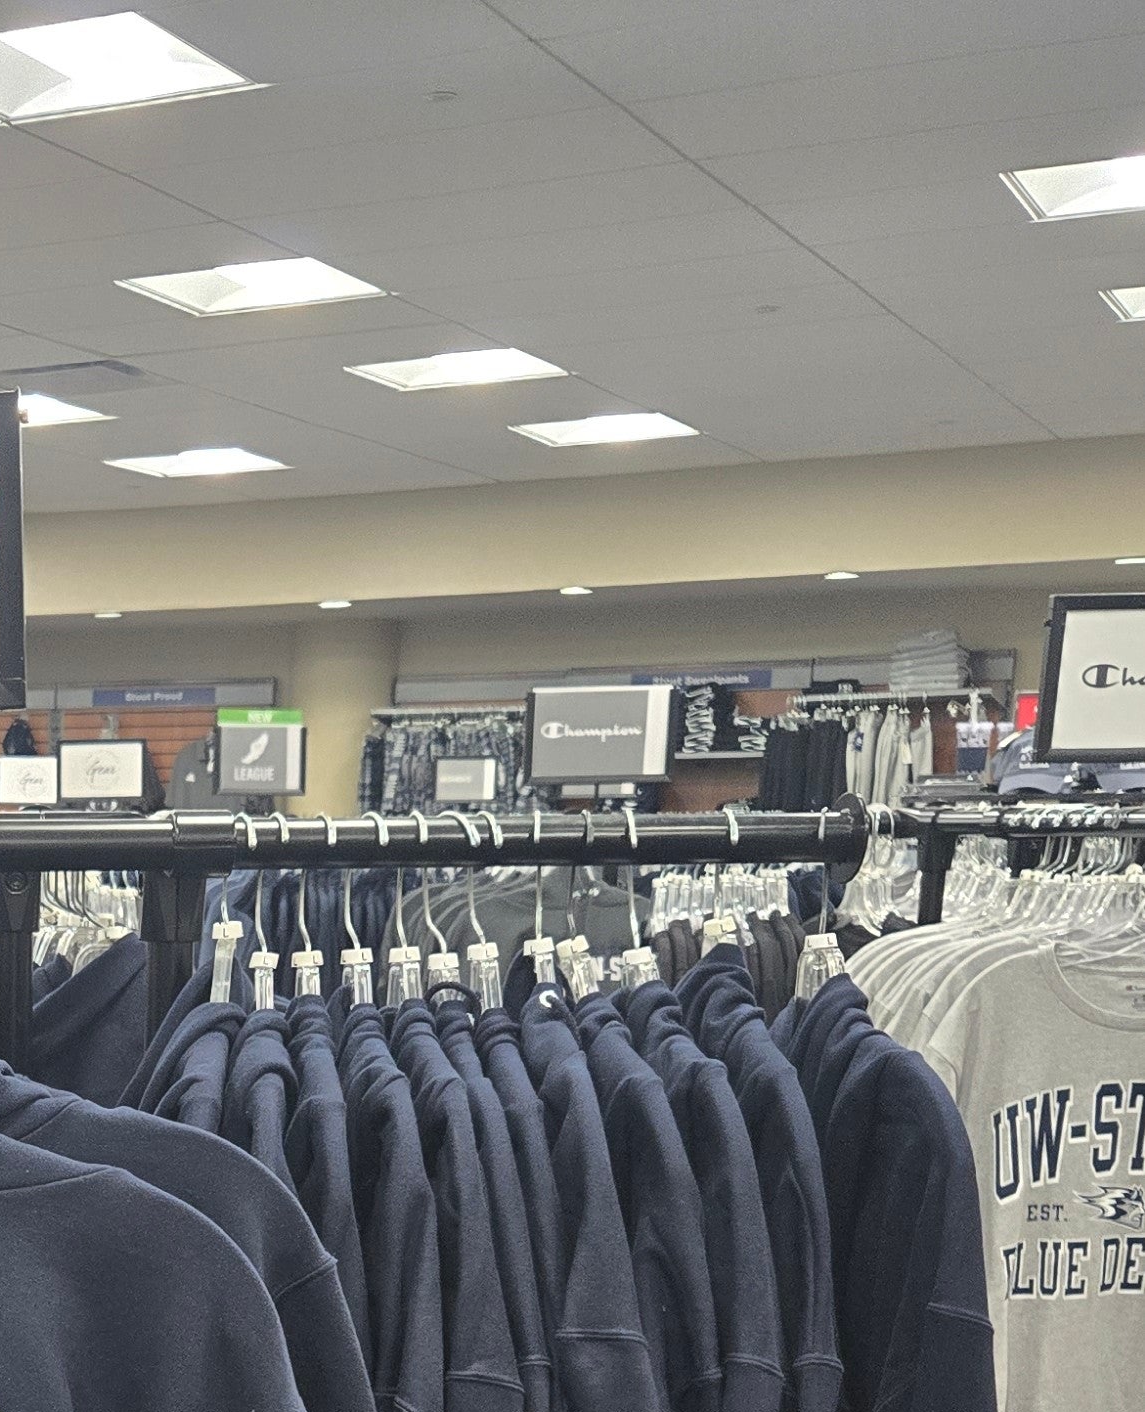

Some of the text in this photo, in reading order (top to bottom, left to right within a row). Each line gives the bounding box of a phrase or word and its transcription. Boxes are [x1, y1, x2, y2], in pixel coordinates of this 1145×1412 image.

[247, 712, 273, 724] NEW
[540, 721, 643, 743] Champion
[233, 766, 275, 782] LEAGUE
[223, 928, 229, 938] L
[1026, 1204, 1069, 1222] EST.
[1002, 1240, 1090, 1300] LUE
